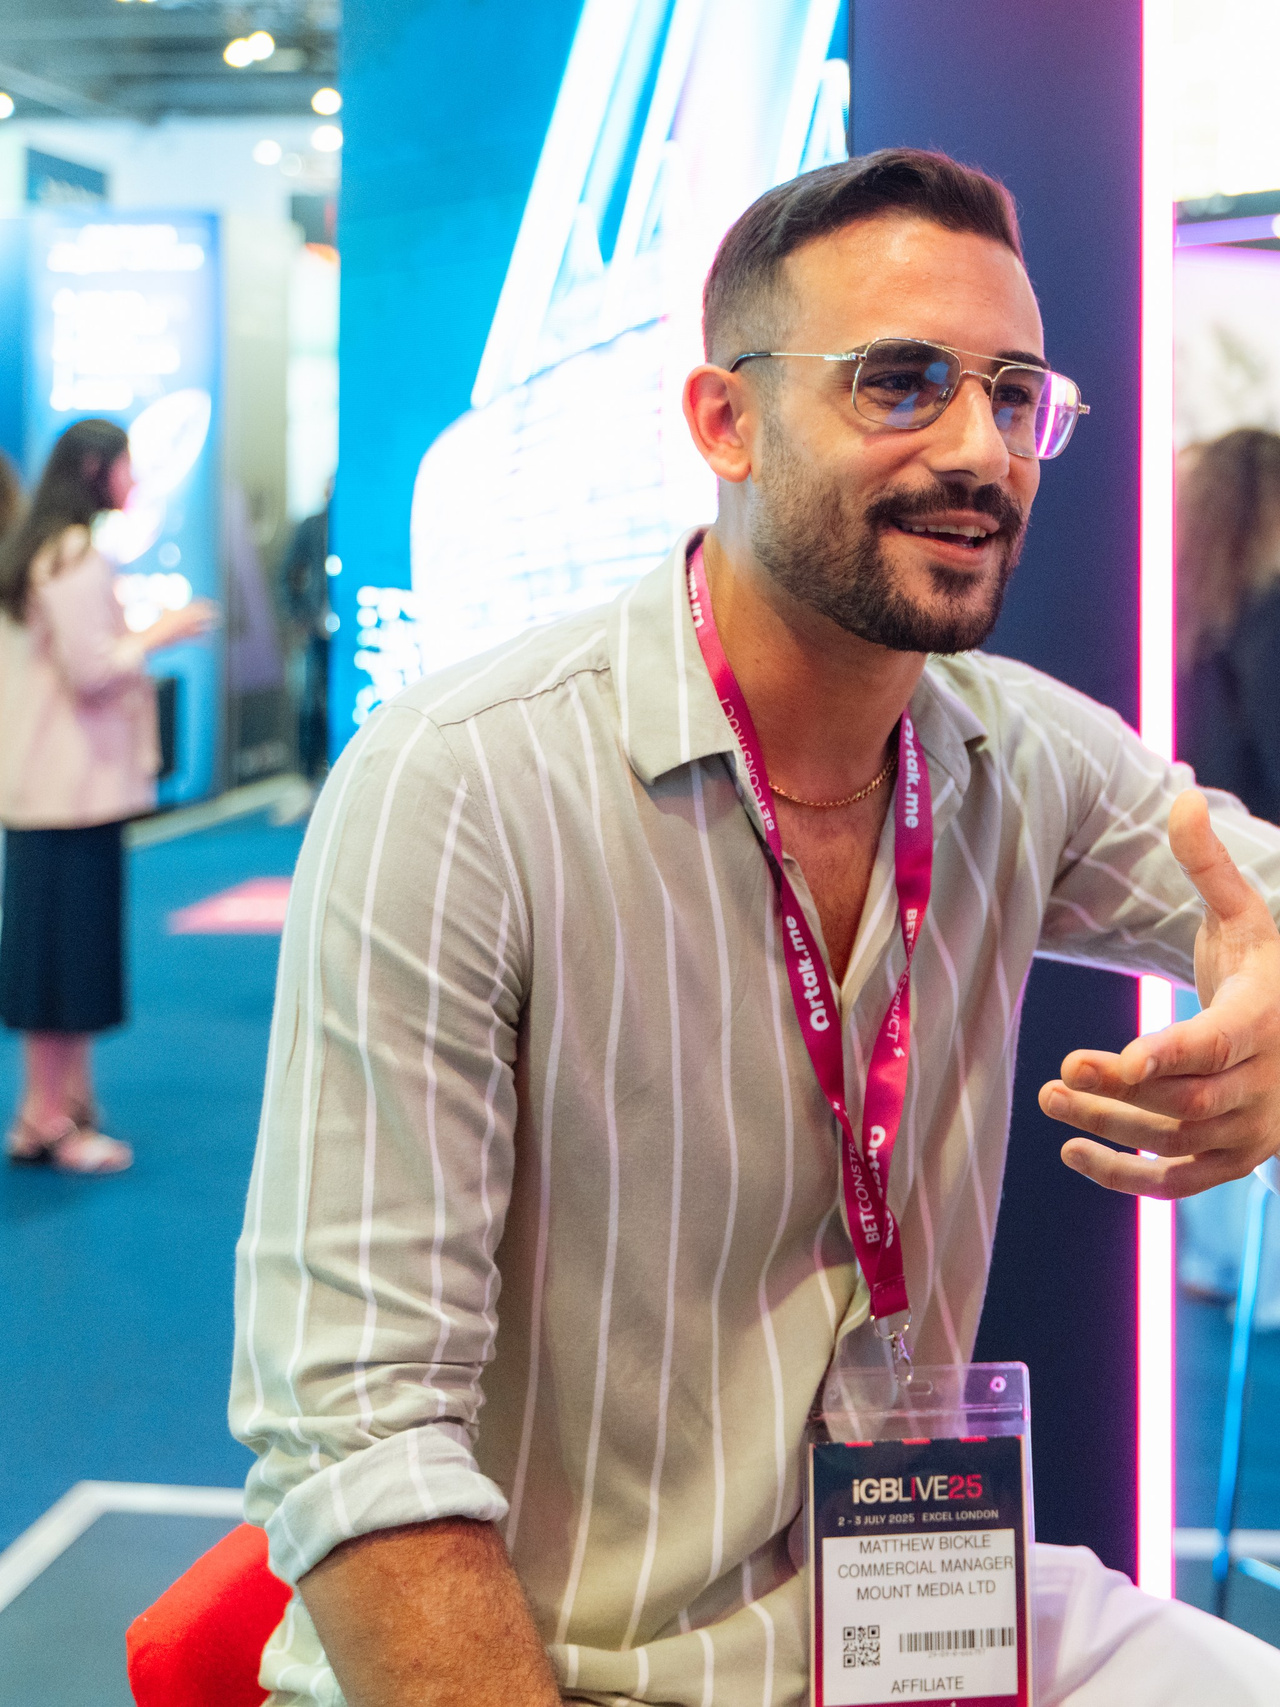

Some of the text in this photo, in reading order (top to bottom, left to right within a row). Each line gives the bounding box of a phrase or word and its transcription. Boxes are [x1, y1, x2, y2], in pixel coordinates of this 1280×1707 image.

[786, 915, 830, 1031] Ortak.me
[837, 1516, 845, 1527] 2
[854, 1515, 862, 1526] 3
[863, 1514, 886, 1526] JULY
[888, 1513, 915, 1523] 2025
[922, 1511, 953, 1523] EXCEL
[956, 1509, 999, 1521] LONDON
[859, 1534, 992, 1554] MATTHEW BICKLE
[837, 1556, 1014, 1579] COMMERCIAL MANAGER
[856, 1579, 996, 1601] MOUNT MEDIA LTD
[891, 1675, 965, 1695] AFFILIATE
